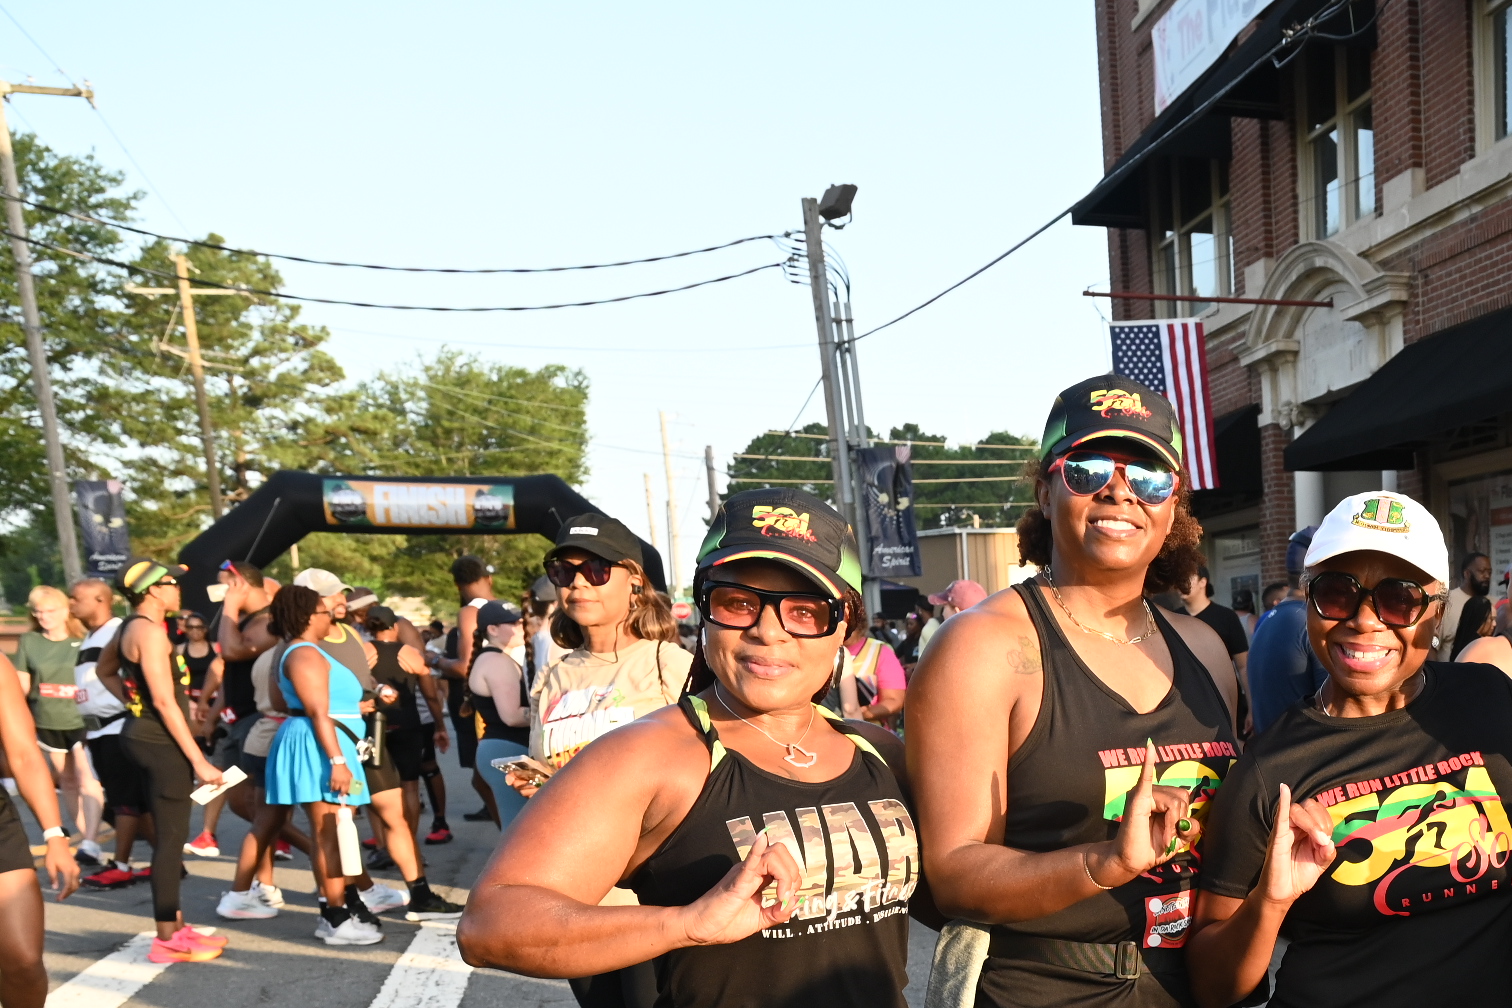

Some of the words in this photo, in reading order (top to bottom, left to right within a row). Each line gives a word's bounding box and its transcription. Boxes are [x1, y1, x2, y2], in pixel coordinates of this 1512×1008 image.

[373, 485, 468, 525] FINISH
[873, 543, 914, 555] American
[881, 556, 910, 569] Spirit
[1098, 750, 1128, 768] WE
[1158, 744, 1203, 763] LITTLE
[1202, 741, 1237, 758] ROCK
[1316, 786, 1346, 808] WE
[1345, 778, 1383, 798] RUN
[1384, 763, 1438, 789] LITTLE
[1436, 751, 1484, 775] ROCK
[726, 799, 920, 920] WAR
[762, 928, 793, 938] WILL
[807, 915, 861, 934] ATTITUDE
